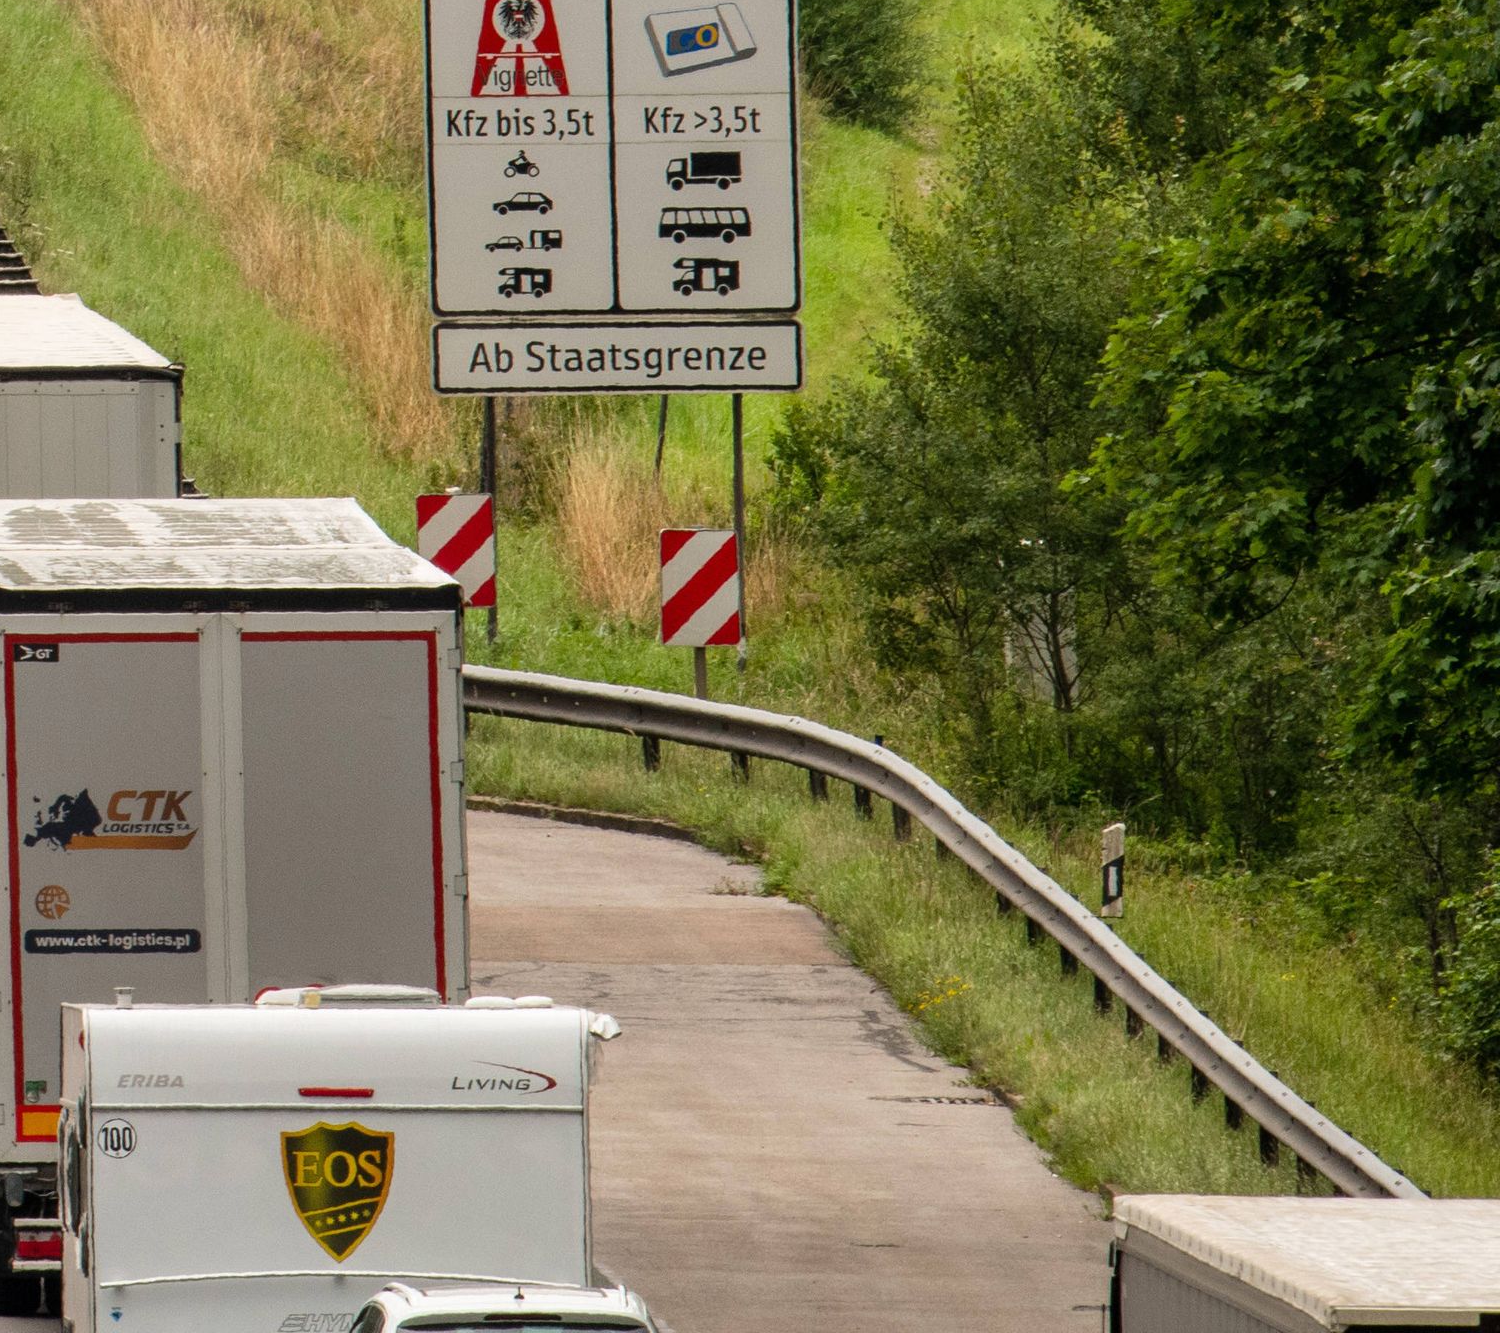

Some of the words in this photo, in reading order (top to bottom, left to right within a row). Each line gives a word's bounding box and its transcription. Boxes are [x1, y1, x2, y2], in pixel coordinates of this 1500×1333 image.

[479, 64, 564, 92] Vignette
[446, 108, 488, 137] Kfz
[497, 107, 535, 137] bis
[543, 108, 595, 141] 3,5t
[644, 106, 685, 134] Kfz
[469, 342, 514, 374] Ab
[525, 341, 767, 379] Staatsgrenze
[35, 649, 53, 660] GT
[107, 790, 193, 822] CTK
[102, 823, 175, 834] LOGISTICS
[35, 933, 190, 950] www.ctk-logistics.pl
[116, 1074, 185, 1089] ERIBA
[101, 1126, 133, 1152] 100
[293, 1149, 383, 1188] EOS
